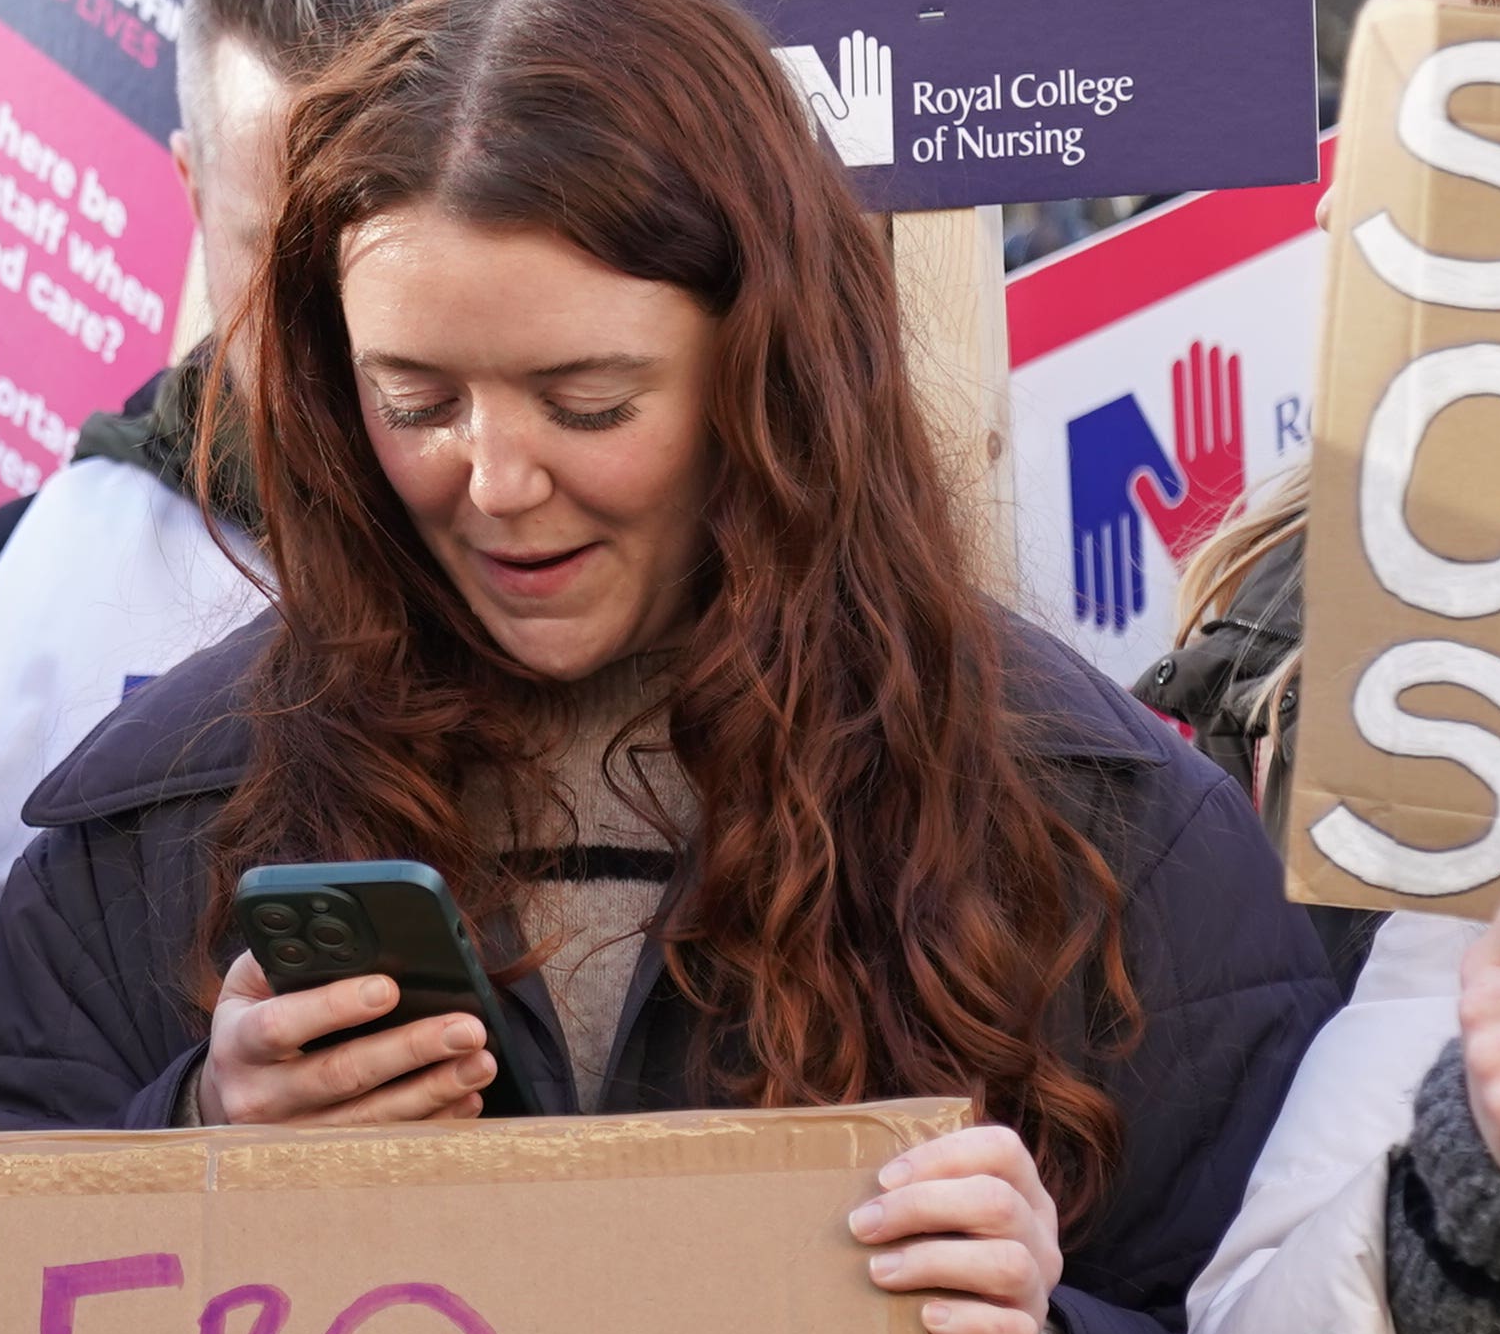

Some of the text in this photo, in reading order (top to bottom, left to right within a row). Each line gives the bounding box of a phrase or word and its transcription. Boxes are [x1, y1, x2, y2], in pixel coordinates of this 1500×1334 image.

[912, 69, 1135, 126] Royal College
[912, 121, 1086, 166] of Nursing
[79, 168, 127, 238] be
[27, 272, 125, 363] care?
[69, 232, 165, 334] when
